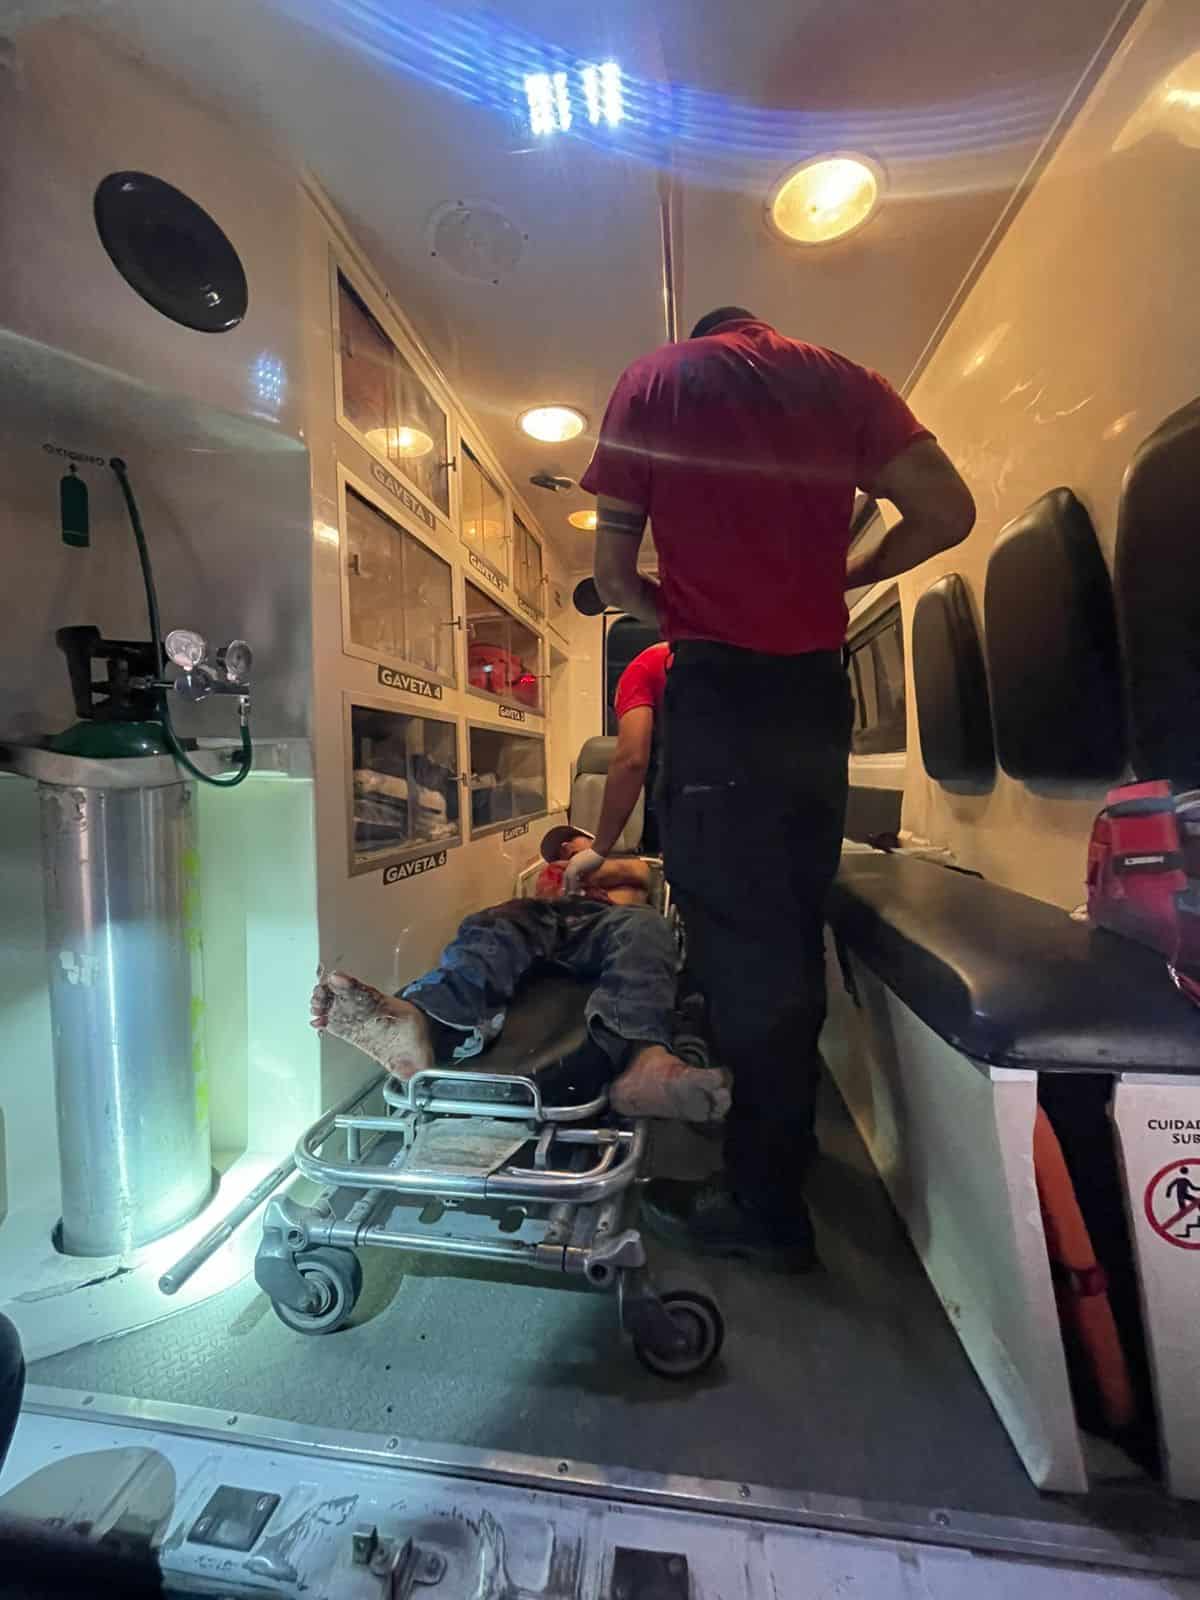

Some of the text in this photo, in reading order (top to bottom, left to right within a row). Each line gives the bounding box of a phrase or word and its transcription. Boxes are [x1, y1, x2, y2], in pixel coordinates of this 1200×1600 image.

[374, 463, 426, 521] GAVETA
[381, 669, 441, 698] GAVETA 4
[385, 851, 446, 882] GAVETA 6
[1171, 1133, 1200, 1145] SUB
